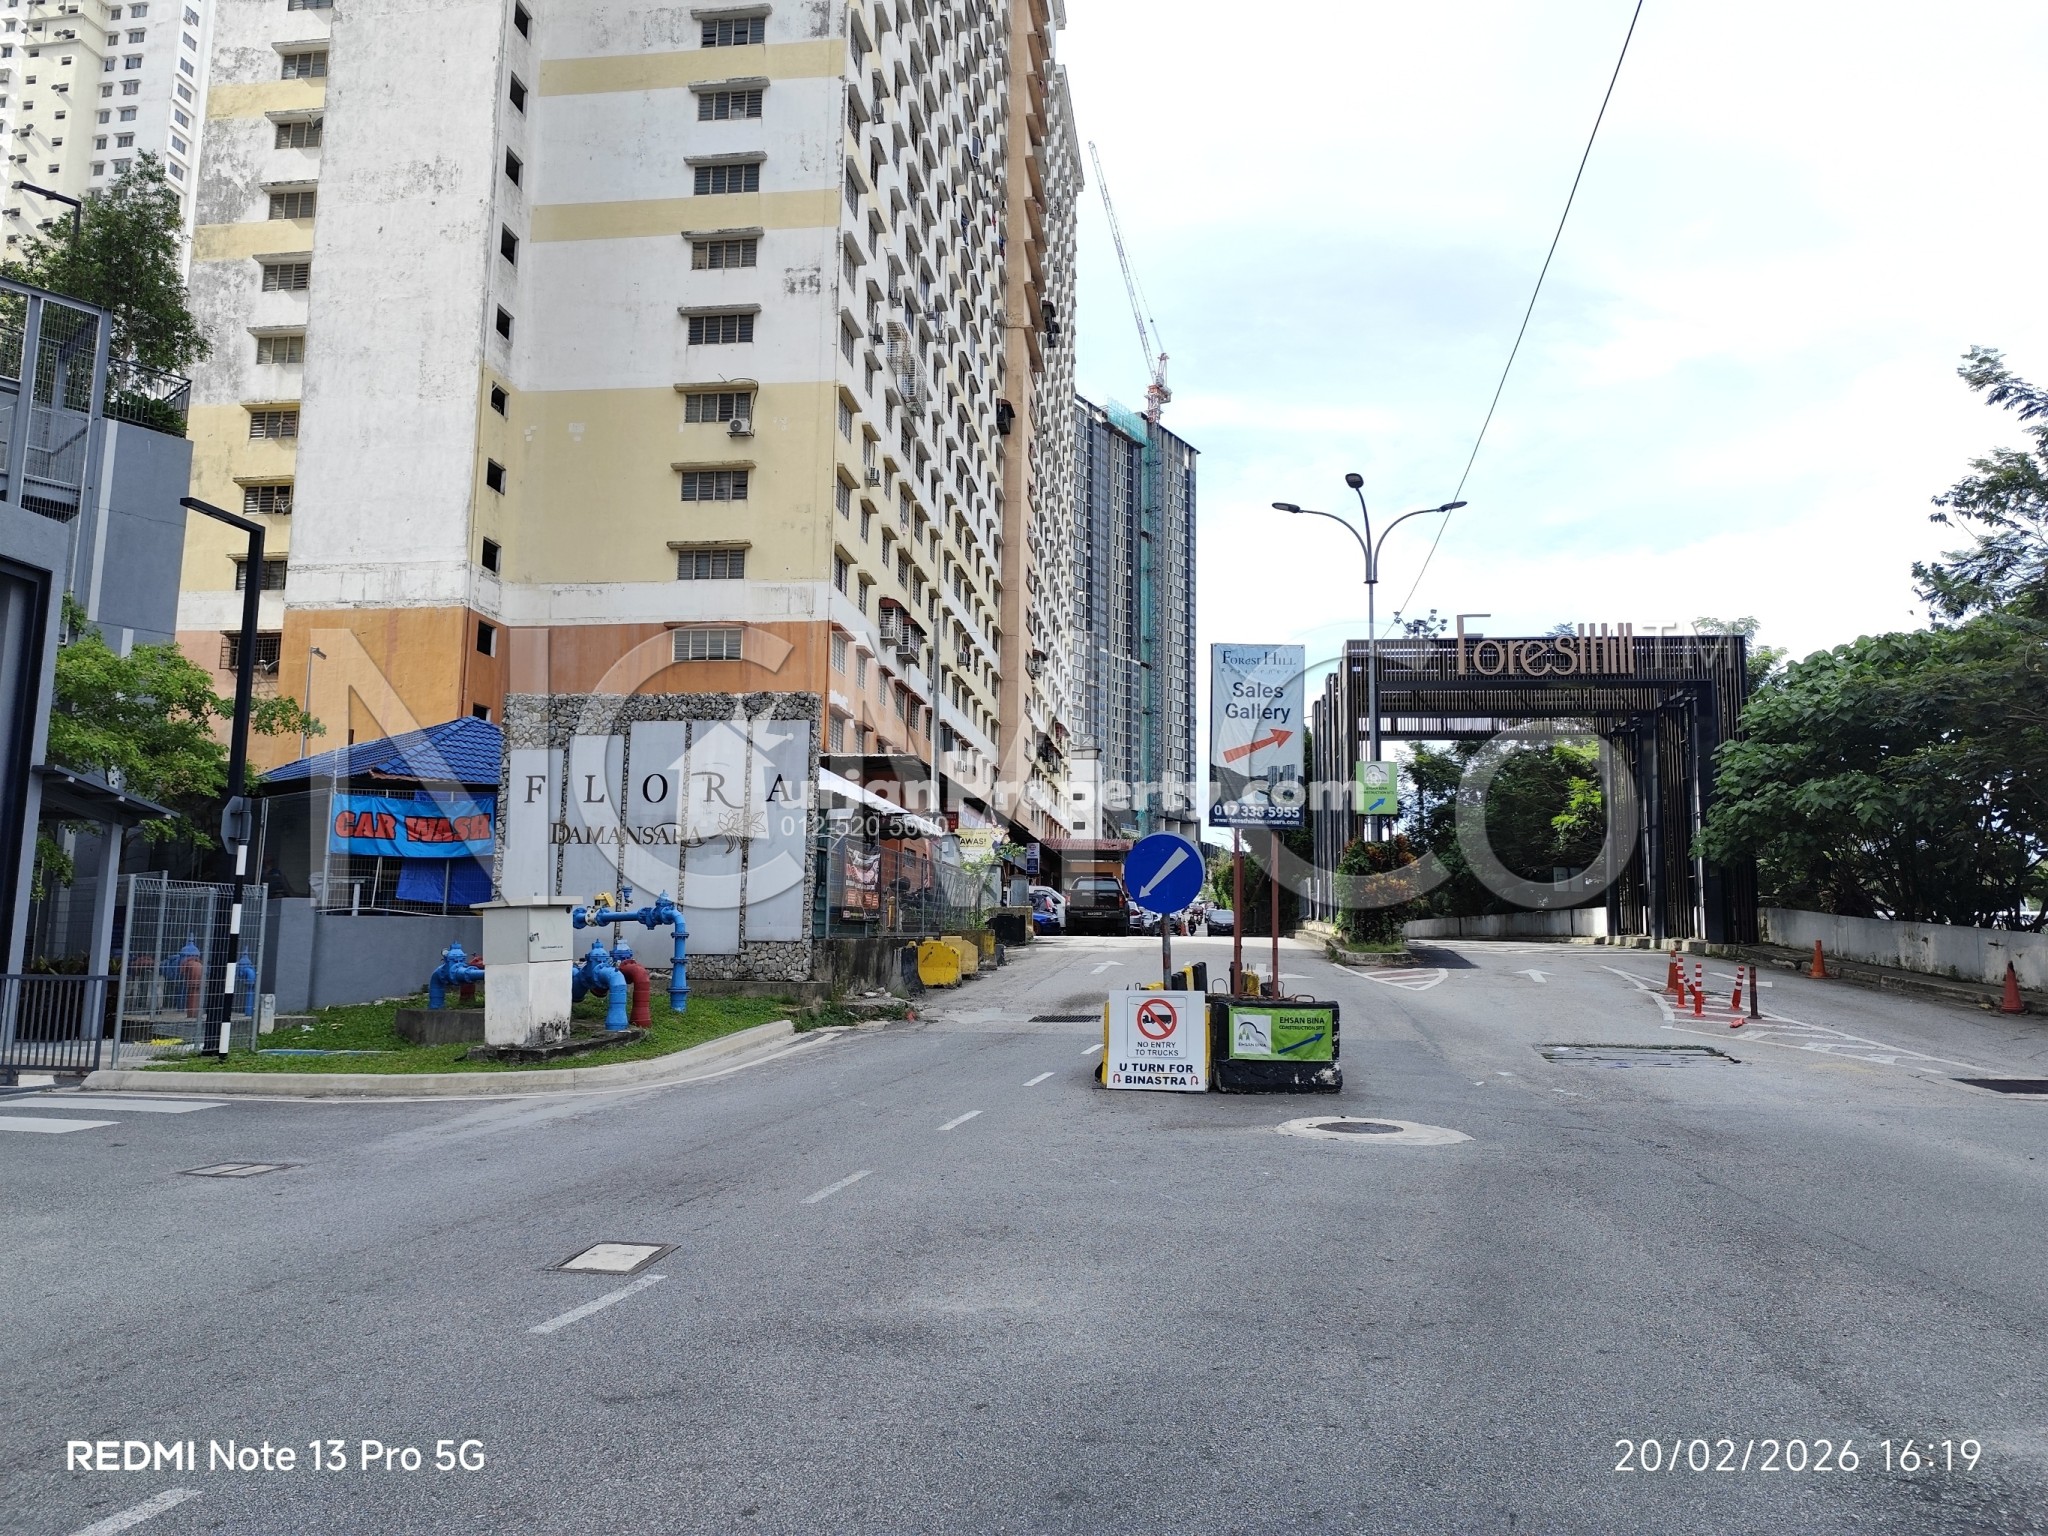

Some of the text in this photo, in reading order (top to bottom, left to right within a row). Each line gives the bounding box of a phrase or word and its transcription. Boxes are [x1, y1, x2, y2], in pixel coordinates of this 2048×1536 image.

[1232, 681, 1284, 698] Sales
[1225, 703, 1291, 724] Gallery
[524, 772, 793, 808] FLORA
[1214, 804, 1238, 816] 017
[1268, 806, 1300, 818] 5955
[335, 810, 491, 843] CAR WASH
[550, 822, 706, 848] DAMANSARA
[1279, 1016, 1325, 1024] EHSAN BINA
[1150, 1041, 1176, 1049] ENTRY
[1119, 1063, 1194, 1073] U TURN FOR
[1125, 1075, 1187, 1085] BINASTRA
